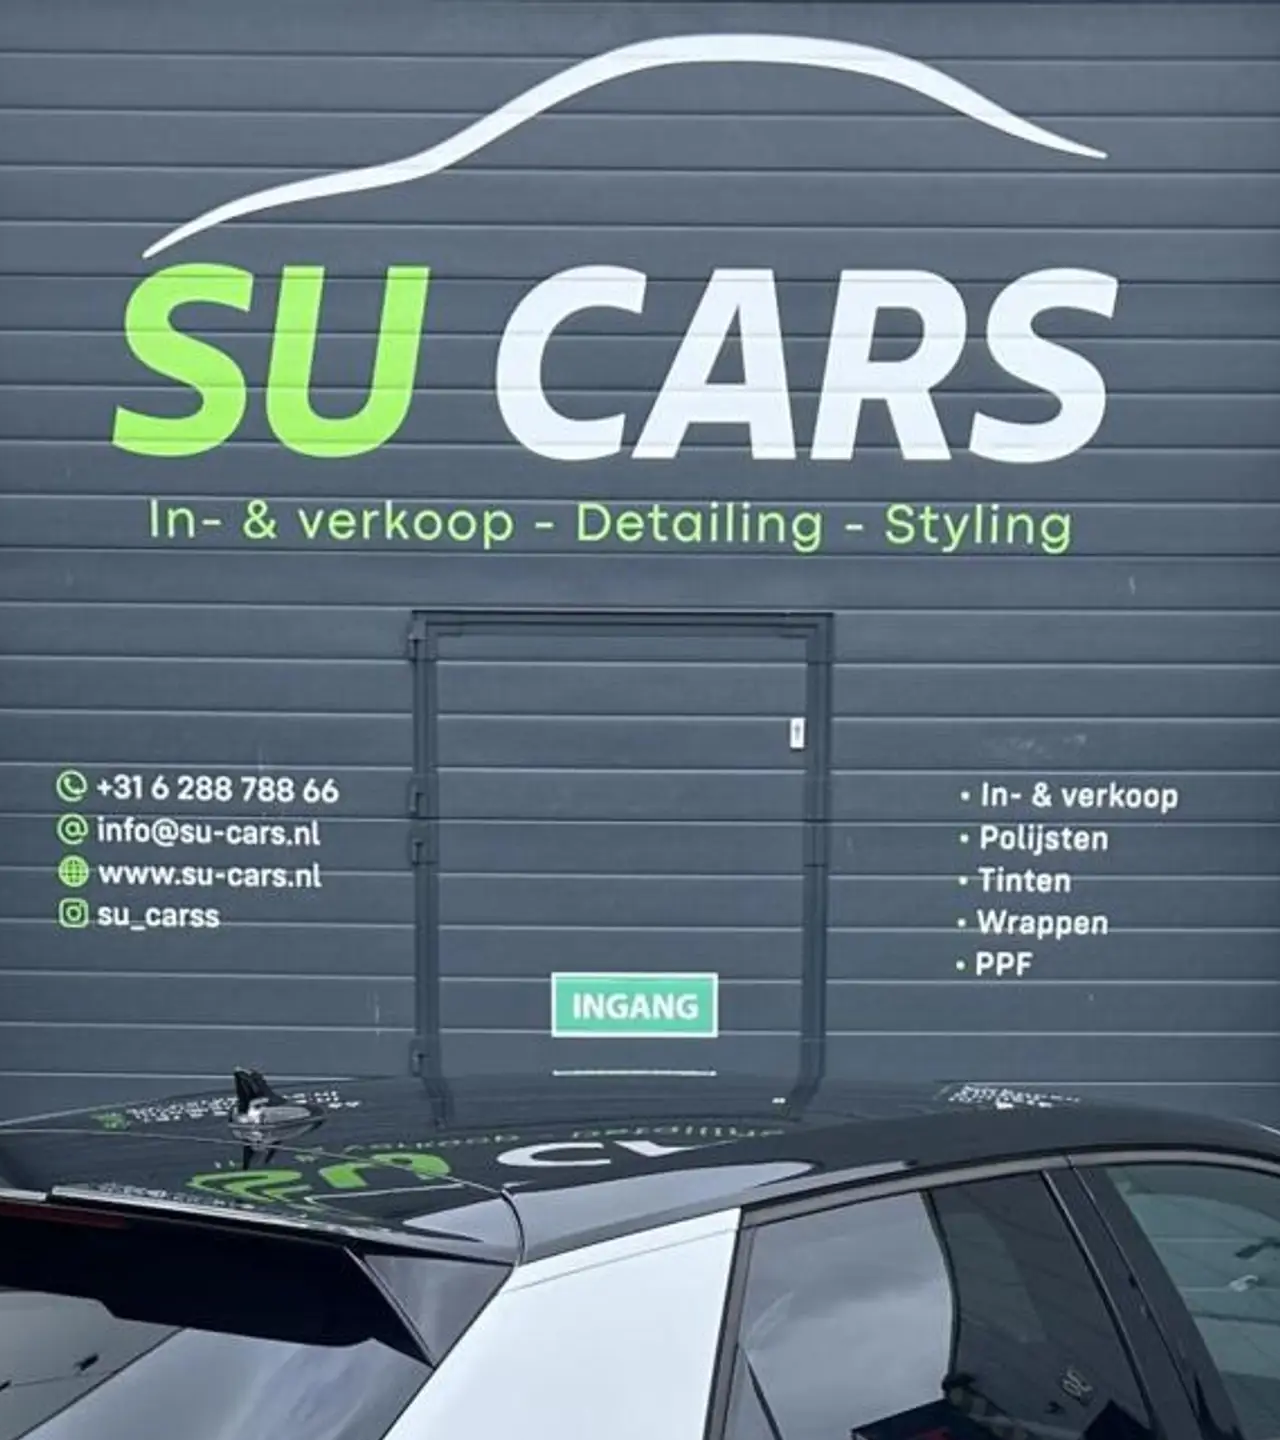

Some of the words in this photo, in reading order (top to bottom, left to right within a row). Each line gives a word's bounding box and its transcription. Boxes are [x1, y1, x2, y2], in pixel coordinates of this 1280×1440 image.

[112, 262, 431, 457] SU
[495, 265, 1118, 463] CARS
[149, 499, 222, 538] In-
[243, 501, 277, 540] &
[301, 500, 513, 550] verkoop
[577, 503, 823, 553] Detailing
[885, 505, 1071, 554] Styling
[96, 775, 142, 799] +31
[151, 776, 169, 799] 6
[177, 776, 233, 801] 288
[241, 777, 294, 802] 788
[303, 778, 339, 803] 66
[981, 782, 1021, 806] In-
[1032, 782, 1052, 807] &
[1061, 781, 1178, 813] verkoop
[97, 817, 320, 847] info@su-cars.nl
[980, 824, 1108, 855] Polijsten
[98, 863, 322, 888] www.su-cars.nl
[978, 867, 1070, 892] Tinten
[97, 905, 220, 930] su_carss
[977, 909, 1108, 940] Wrappen
[976, 952, 1033, 976] PPF
[573, 993, 699, 1020] INGANG
